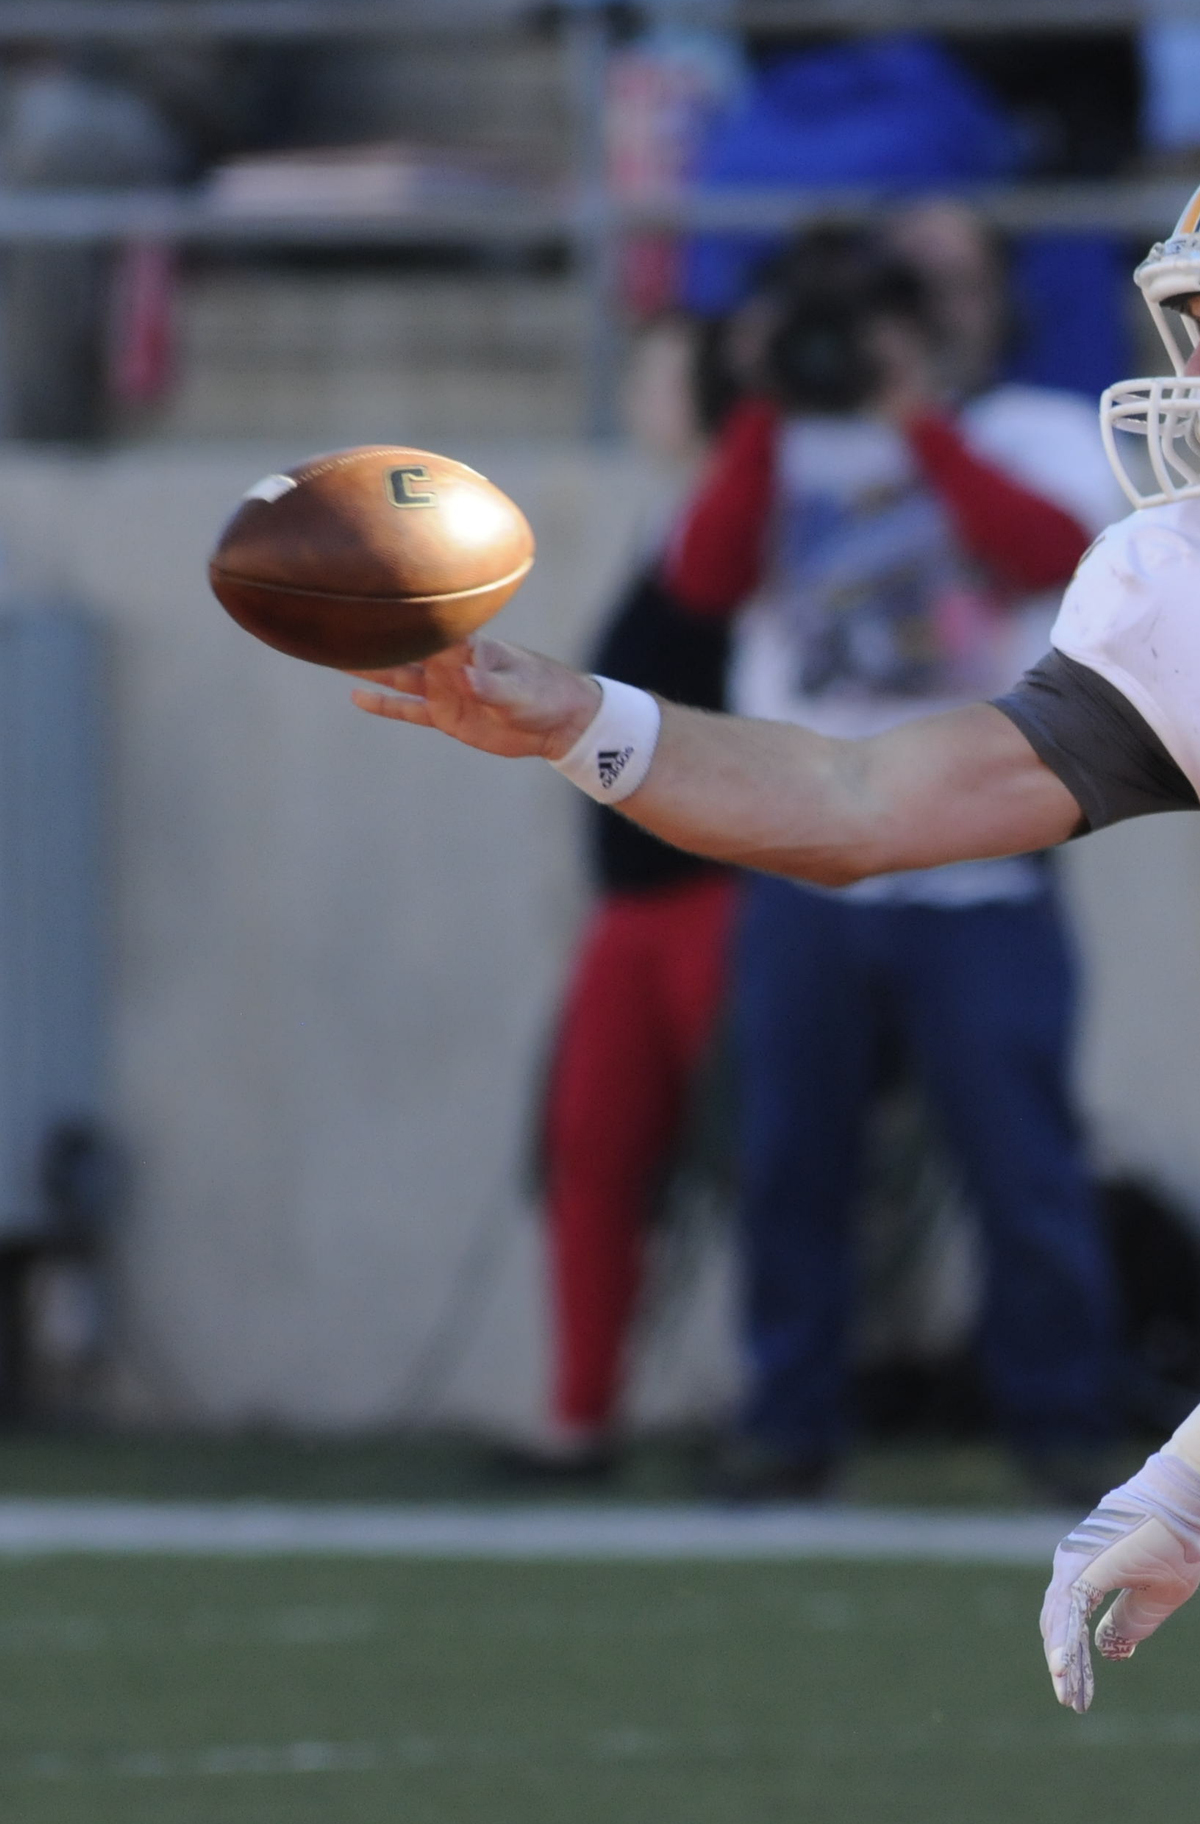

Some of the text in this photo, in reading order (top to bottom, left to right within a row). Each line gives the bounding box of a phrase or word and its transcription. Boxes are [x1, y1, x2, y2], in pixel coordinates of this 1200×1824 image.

[358, 150, 467, 263] C
[385, 465, 438, 509] C
[602, 746, 634, 789] adidas
